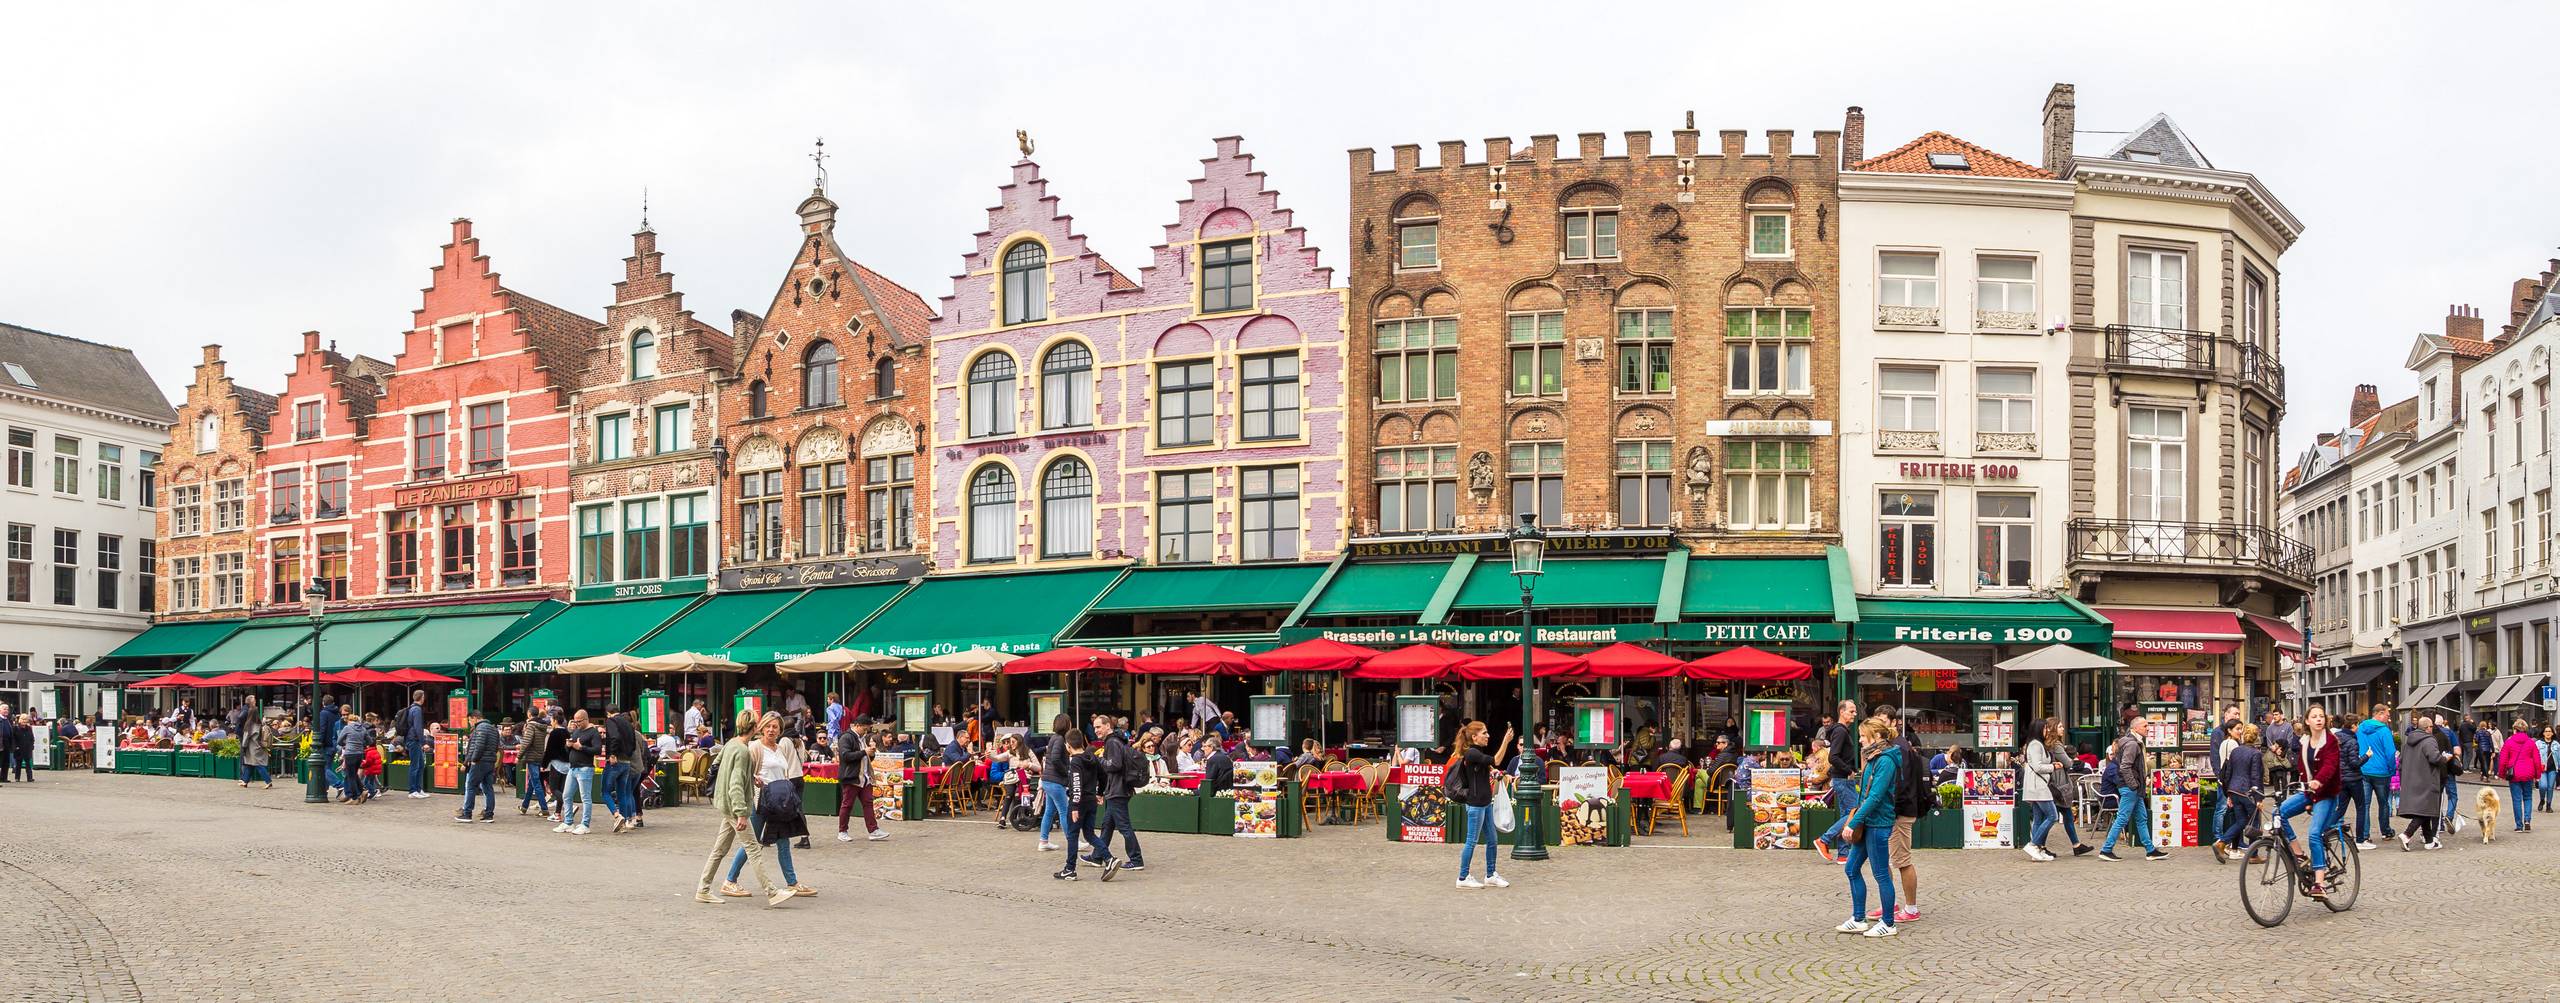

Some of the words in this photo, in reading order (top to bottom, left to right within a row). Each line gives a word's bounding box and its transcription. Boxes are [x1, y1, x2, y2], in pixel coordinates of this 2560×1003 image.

[1728, 421, 1743, 434] AU
[1747, 421, 1779, 434] PETIT
[1782, 421, 1809, 434] CAFE
[1900, 462, 1975, 479] FRITERIE
[1980, 464, 2019, 479] 1900
[400, 493, 418, 506] LE
[422, 483, 475, 503] PANIER
[1356, 540, 1482, 556] RESTAURANT
[1624, 536, 1669, 549] D'OR
[1918, 540, 1927, 565] 1900
[740, 573, 765, 589] Grand
[799, 566, 835, 585] Central
[852, 565, 898, 578] Brasserie
[615, 586, 635, 596] SINT
[637, 584, 662, 595] JORIS
[1323, 630, 1395, 642] Brasserie
[1409, 629, 1427, 641] La
[1431, 629, 1485, 642] Civiere
[1489, 629, 1522, 642] d'Or
[1536, 627, 1617, 641] Restaurant
[1705, 624, 1758, 639] PETIT
[1763, 624, 1810, 639] CAFE
[1895, 627, 1992, 641] Friterie
[2004, 628, 2072, 641] 1900
[870, 646, 884, 655] La
[888, 644, 927, 656] Sirene
[931, 643, 958, 655] d'Or
[1000, 642, 1009, 651] &
[1013, 642, 1040, 653] pasta
[2136, 640, 2204, 651] SOUVENIRS
[1936, 679, 1957, 689] 1900
[1404, 765, 1444, 775] MOULES
[1407, 775, 1441, 785] FRITES
[1073, 772, 1081, 803] ADDICTED
